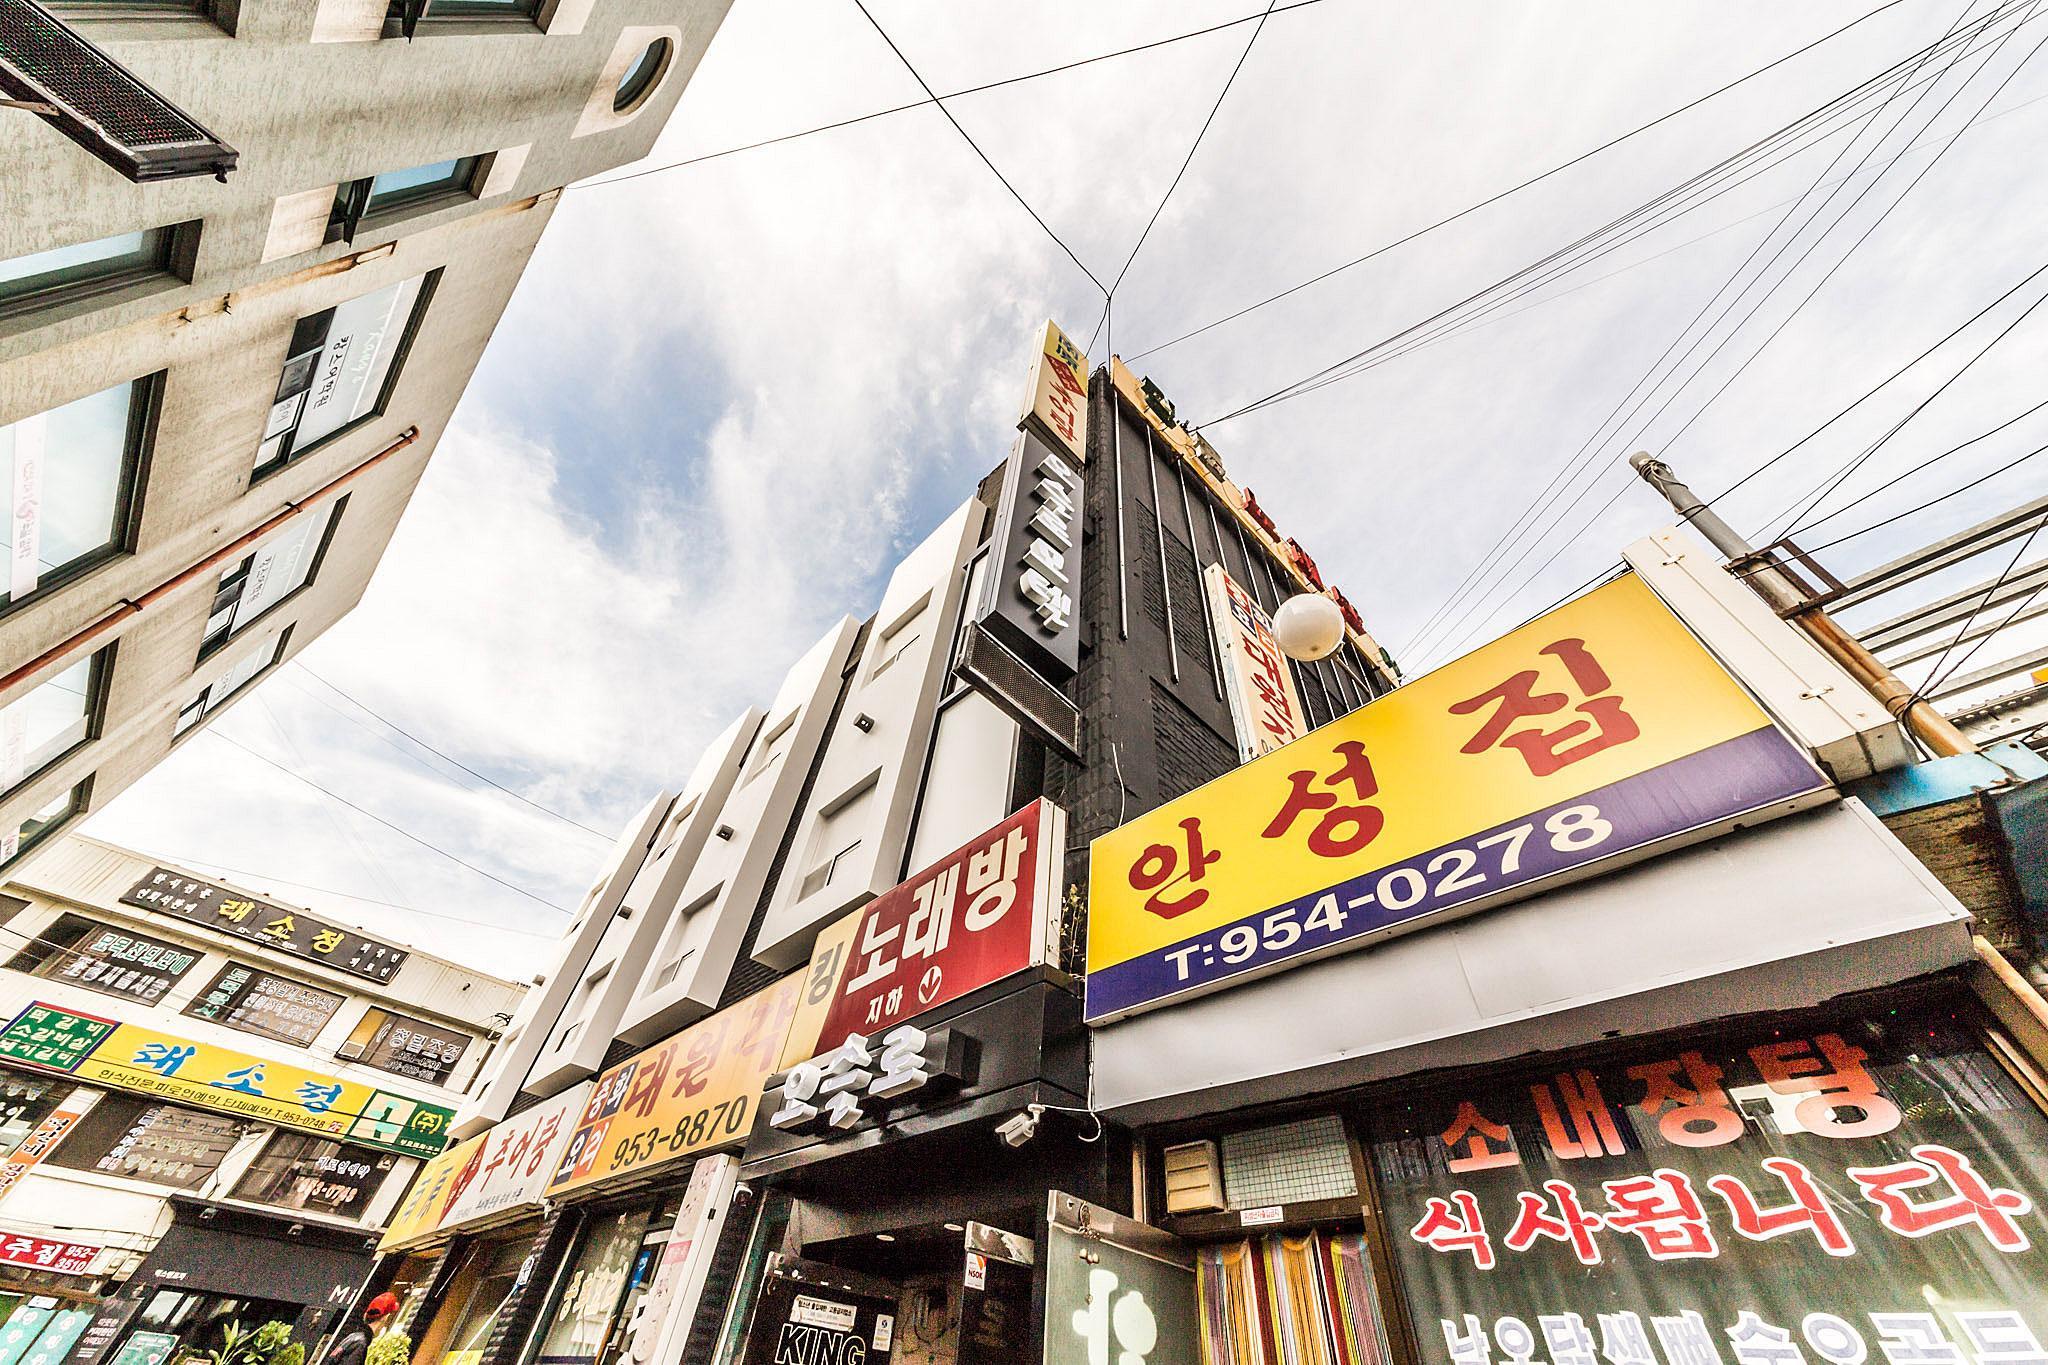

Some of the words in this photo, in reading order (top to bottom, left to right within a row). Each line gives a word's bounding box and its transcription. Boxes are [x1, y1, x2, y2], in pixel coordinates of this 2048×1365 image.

[1129, 638, 1640, 920] 안성집
[219, 898, 346, 954] 래소정
[846, 825, 1028, 996] 노래방
[1164, 804, 1614, 983] T:954-0278
[808, 941, 845, 1006] 킹
[865, 985, 903, 1025] 지하
[10, 1024, 92, 1050] 소갈비살
[624, 986, 796, 1119] 대원각
[132, 1043, 343, 1113] 래소정
[589, 1064, 635, 1119] 중화
[1441, 1033, 1902, 1174] 소내장탕
[480, 1106, 566, 1193] 추어탕
[558, 1120, 609, 1176] 요리
[610, 1095, 748, 1171] 953-8870
[1410, 1144, 2033, 1271] 식사됩니다
[0, 1235, 65, 1265] 주집
[54, 1257, 88, 1272] 3510
[775, 1323, 866, 1365] KING
